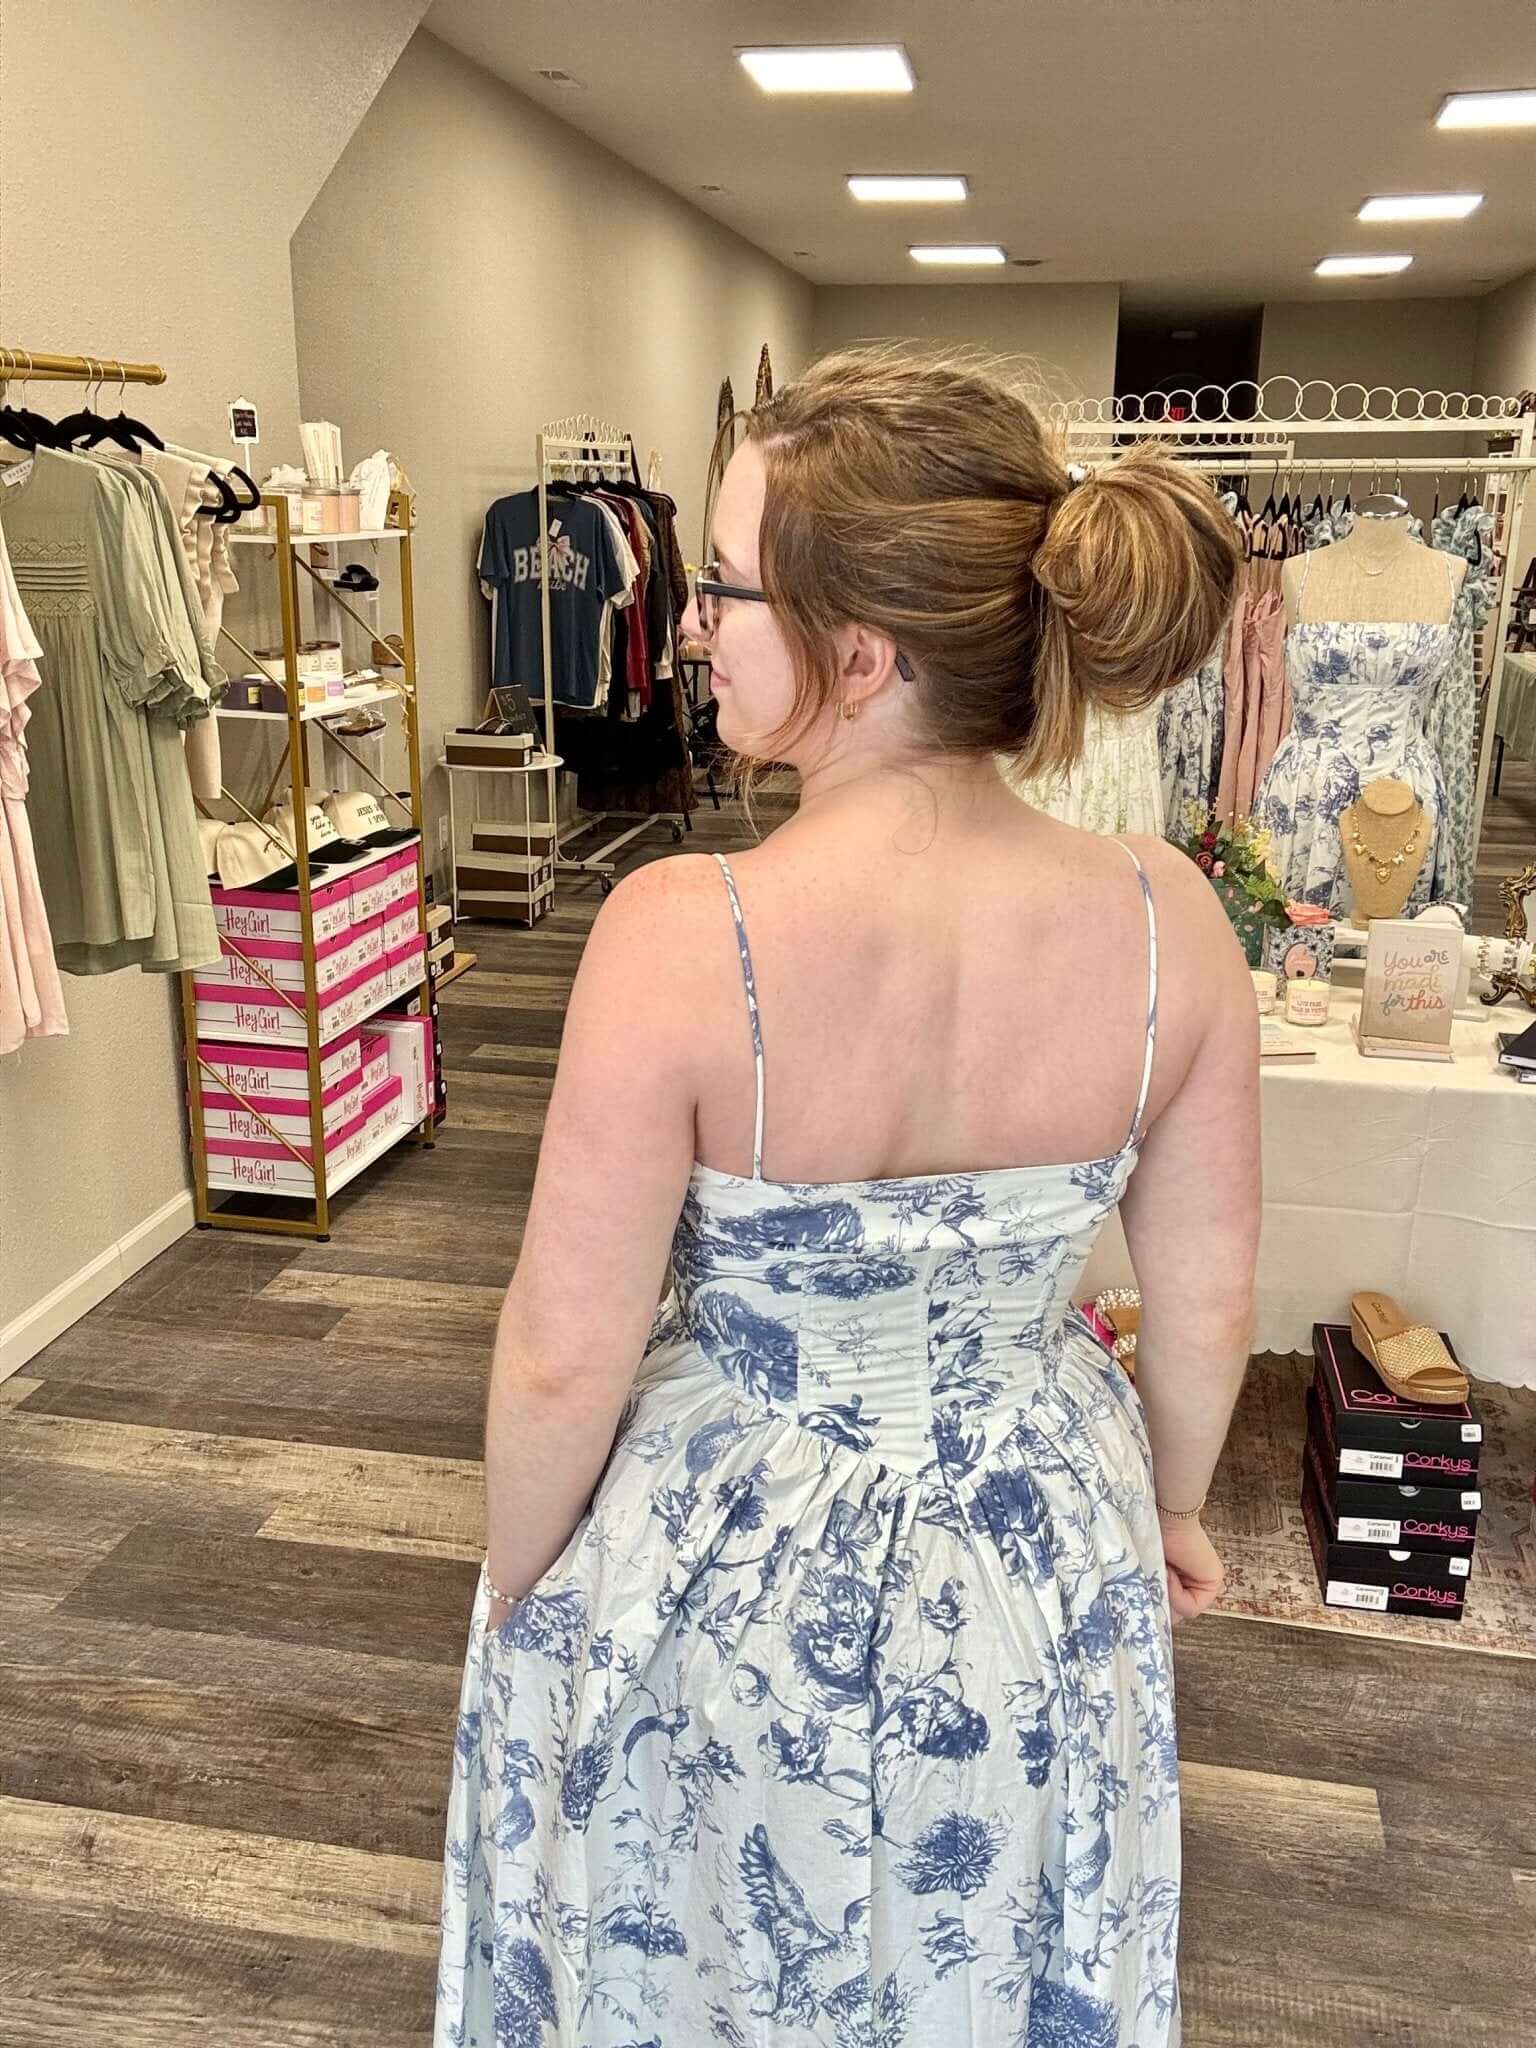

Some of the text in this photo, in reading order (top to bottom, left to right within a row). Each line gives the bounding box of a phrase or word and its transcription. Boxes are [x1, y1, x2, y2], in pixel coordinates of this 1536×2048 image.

[513, 546, 590, 591] BEACH
[1384, 950, 1450, 977] You are
[1380, 990, 1446, 1016] for this
[1405, 1452, 1472, 1472] Corkys
[1404, 1519, 1469, 1538] Corkys
[1393, 1583, 1457, 1603] Corkys
